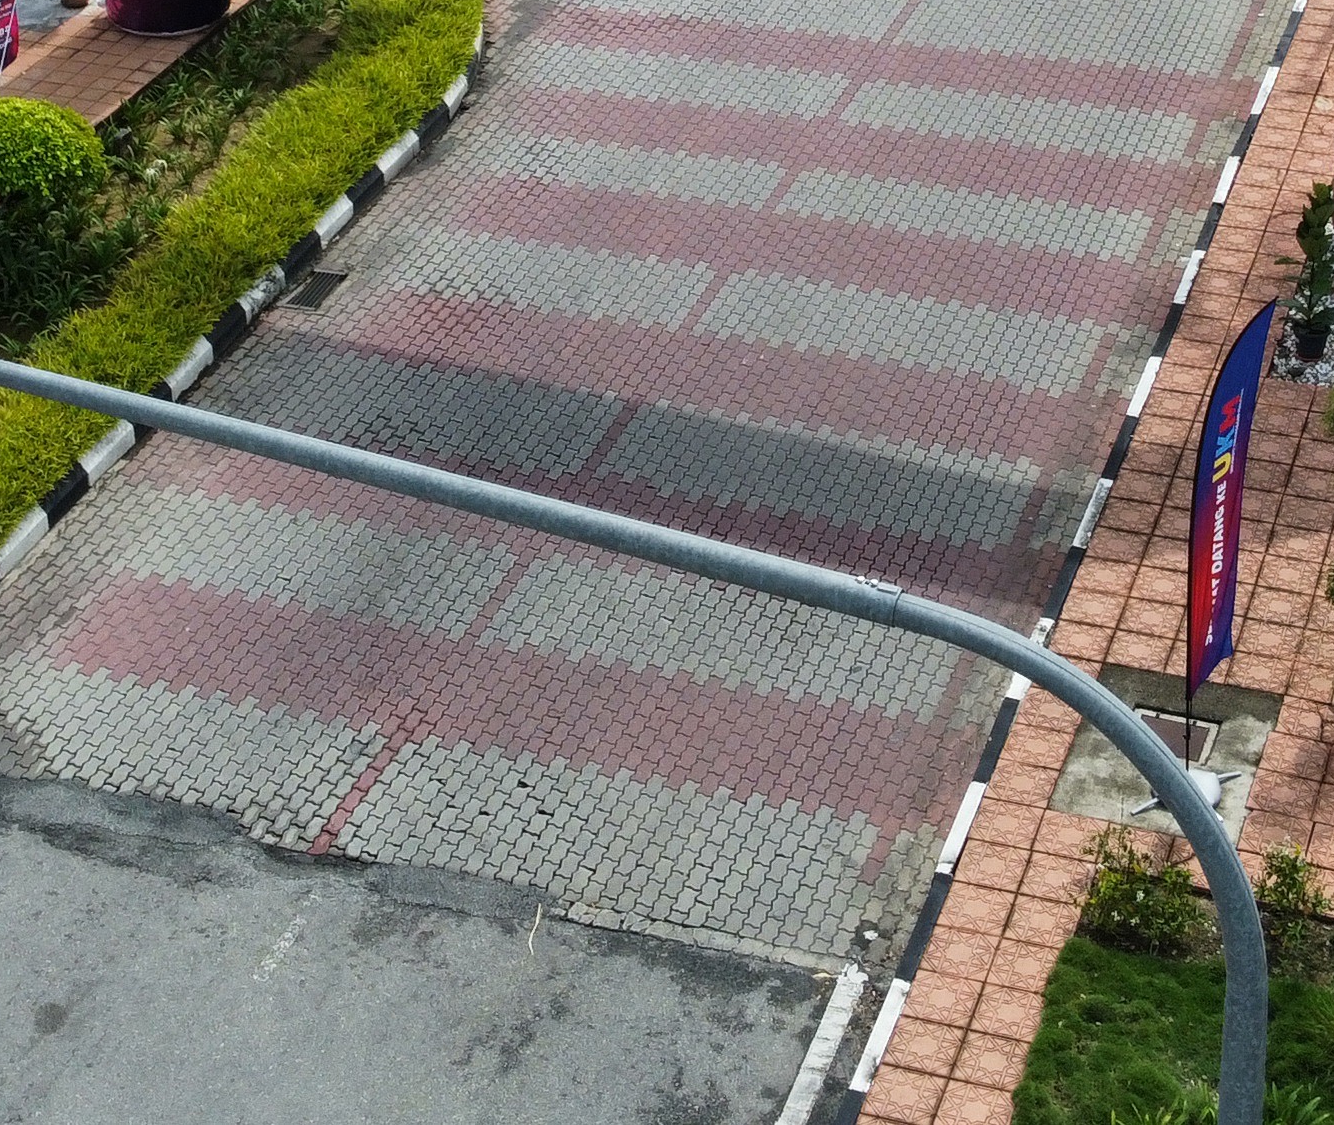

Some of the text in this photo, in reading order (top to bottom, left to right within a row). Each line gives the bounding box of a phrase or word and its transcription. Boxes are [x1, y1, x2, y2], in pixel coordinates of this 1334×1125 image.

[1211, 395, 1241, 483] UKM
[1215, 480, 1227, 505] KE
[1211, 506, 1225, 572] DATANG
